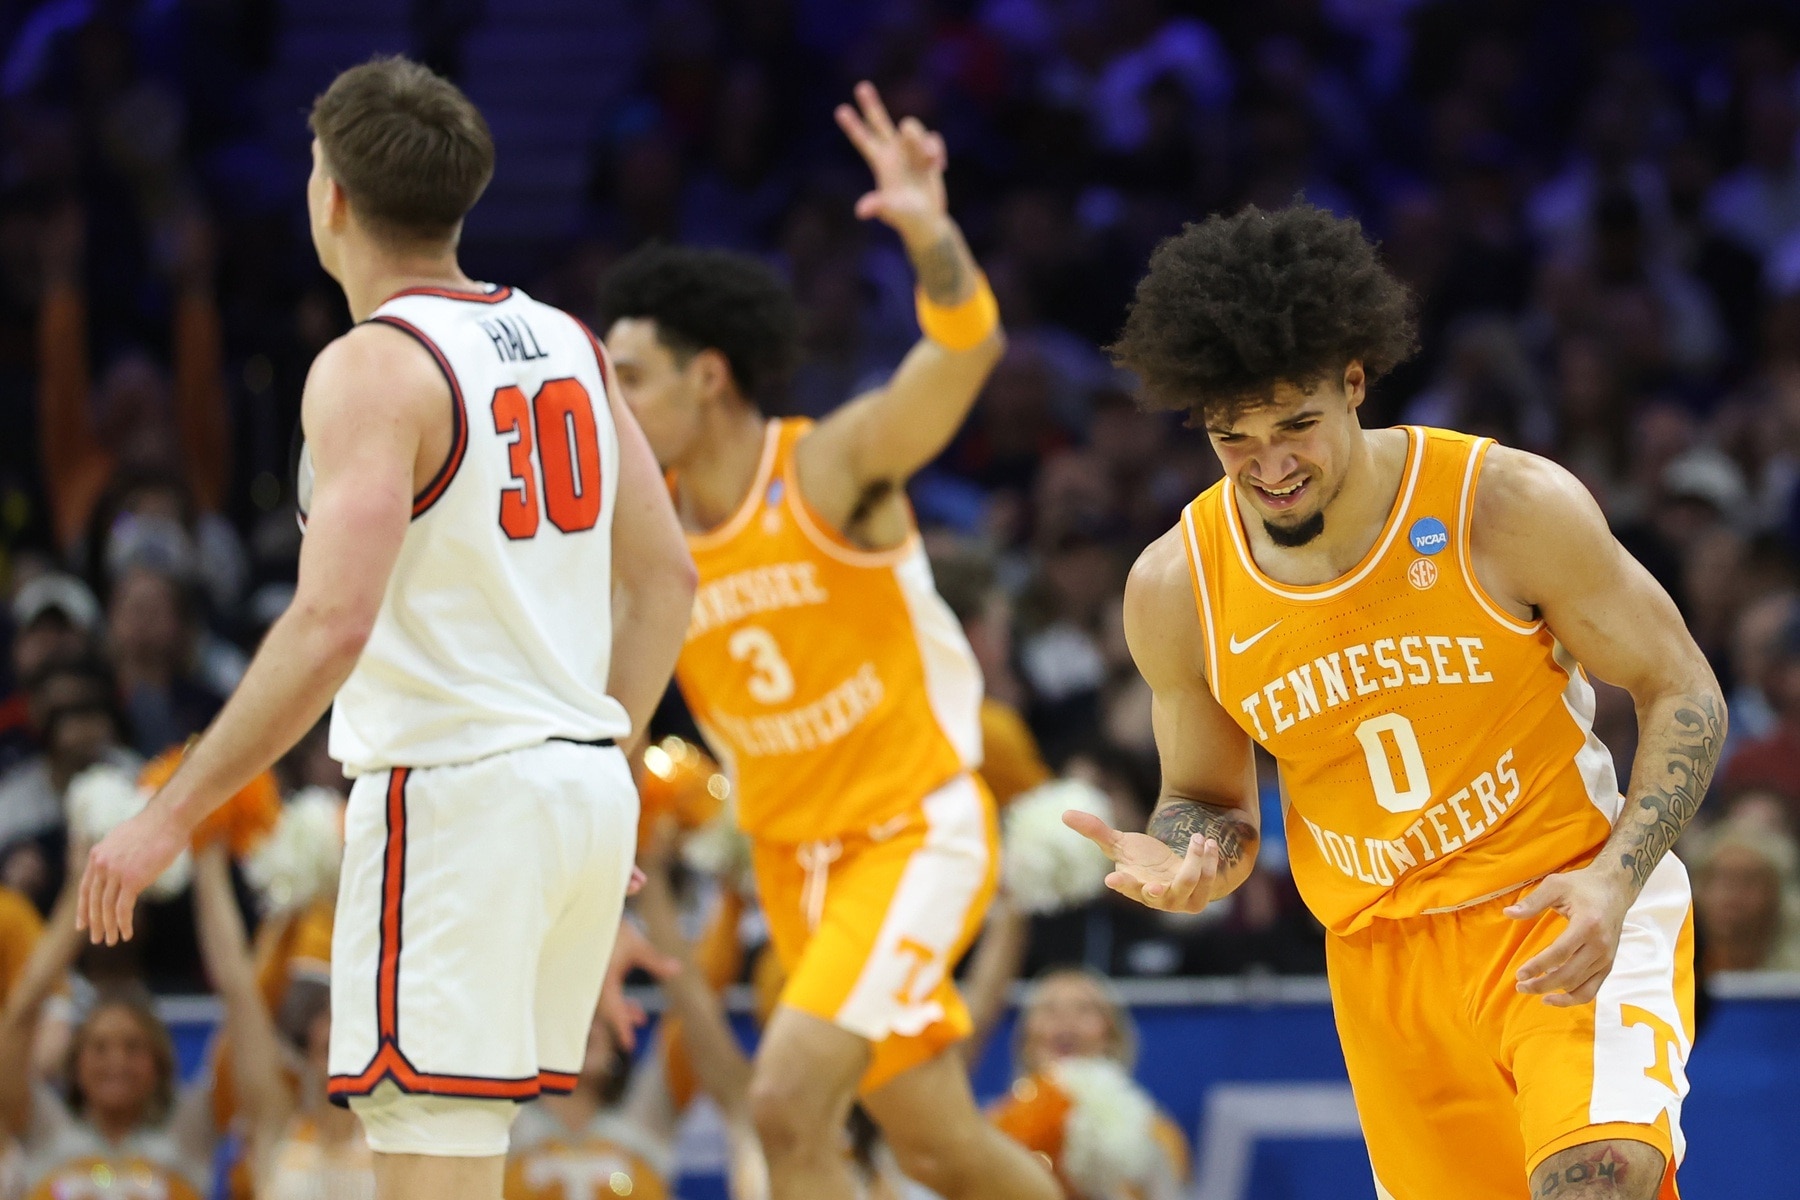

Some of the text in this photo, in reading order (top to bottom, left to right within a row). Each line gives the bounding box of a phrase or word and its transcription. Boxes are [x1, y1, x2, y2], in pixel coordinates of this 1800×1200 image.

[480, 314, 548, 362] HALL
[491, 377, 601, 540] 30
[1410, 560, 1435, 587] SEC
[1416, 532, 1447, 547] NCAA
[683, 560, 829, 642] NNESSEE
[728, 625, 795, 705] 3
[1241, 635, 1494, 741] TENNESSEE
[1354, 712, 1432, 814] 0
[1301, 747, 1520, 887] VOLUNTEERS
[1620, 1003, 1685, 1098] T
